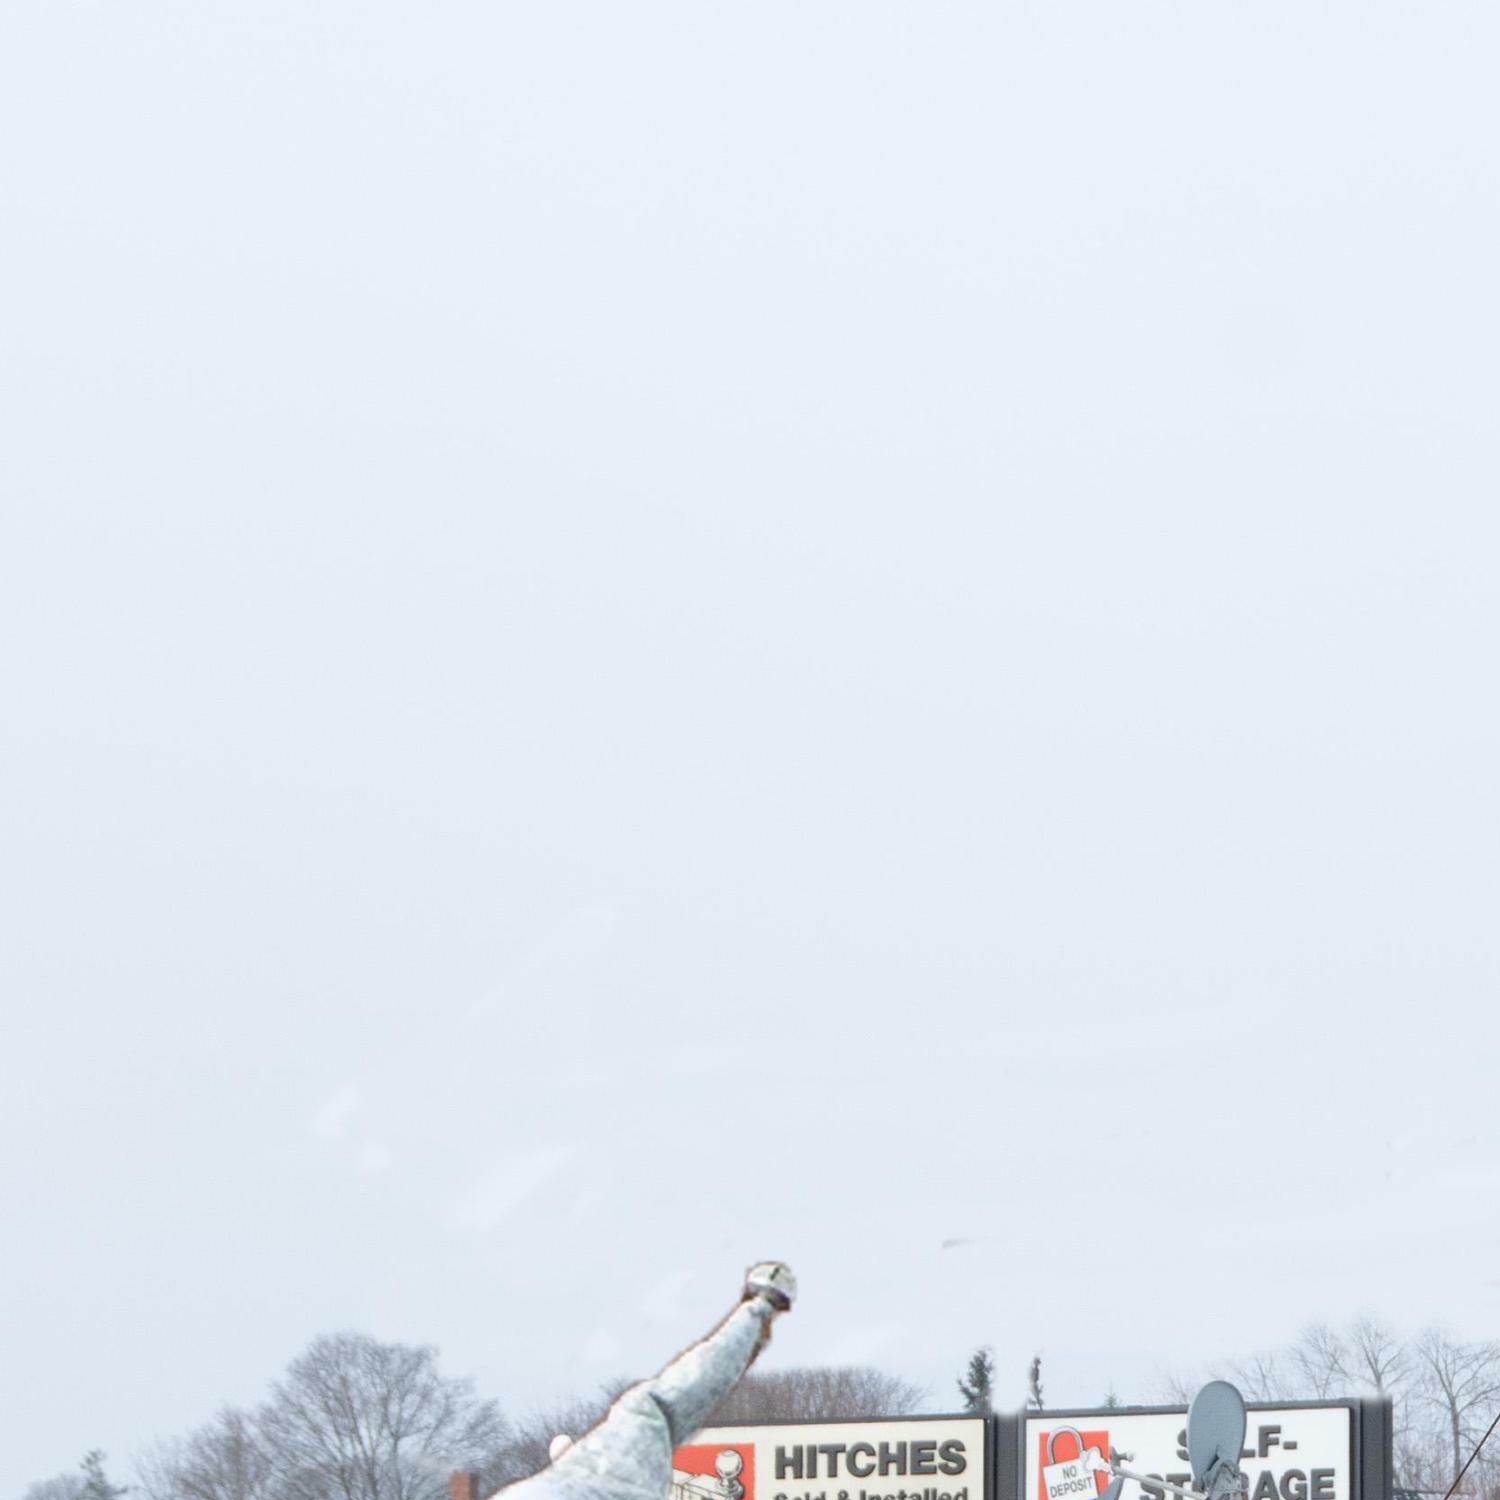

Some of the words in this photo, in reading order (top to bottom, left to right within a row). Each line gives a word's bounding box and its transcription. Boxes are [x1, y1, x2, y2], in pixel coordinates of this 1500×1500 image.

[774, 1439, 967, 1480] HITCHES
[1062, 1465, 1077, 1480] NO
[1050, 1476, 1092, 1498] DEPOSIT
